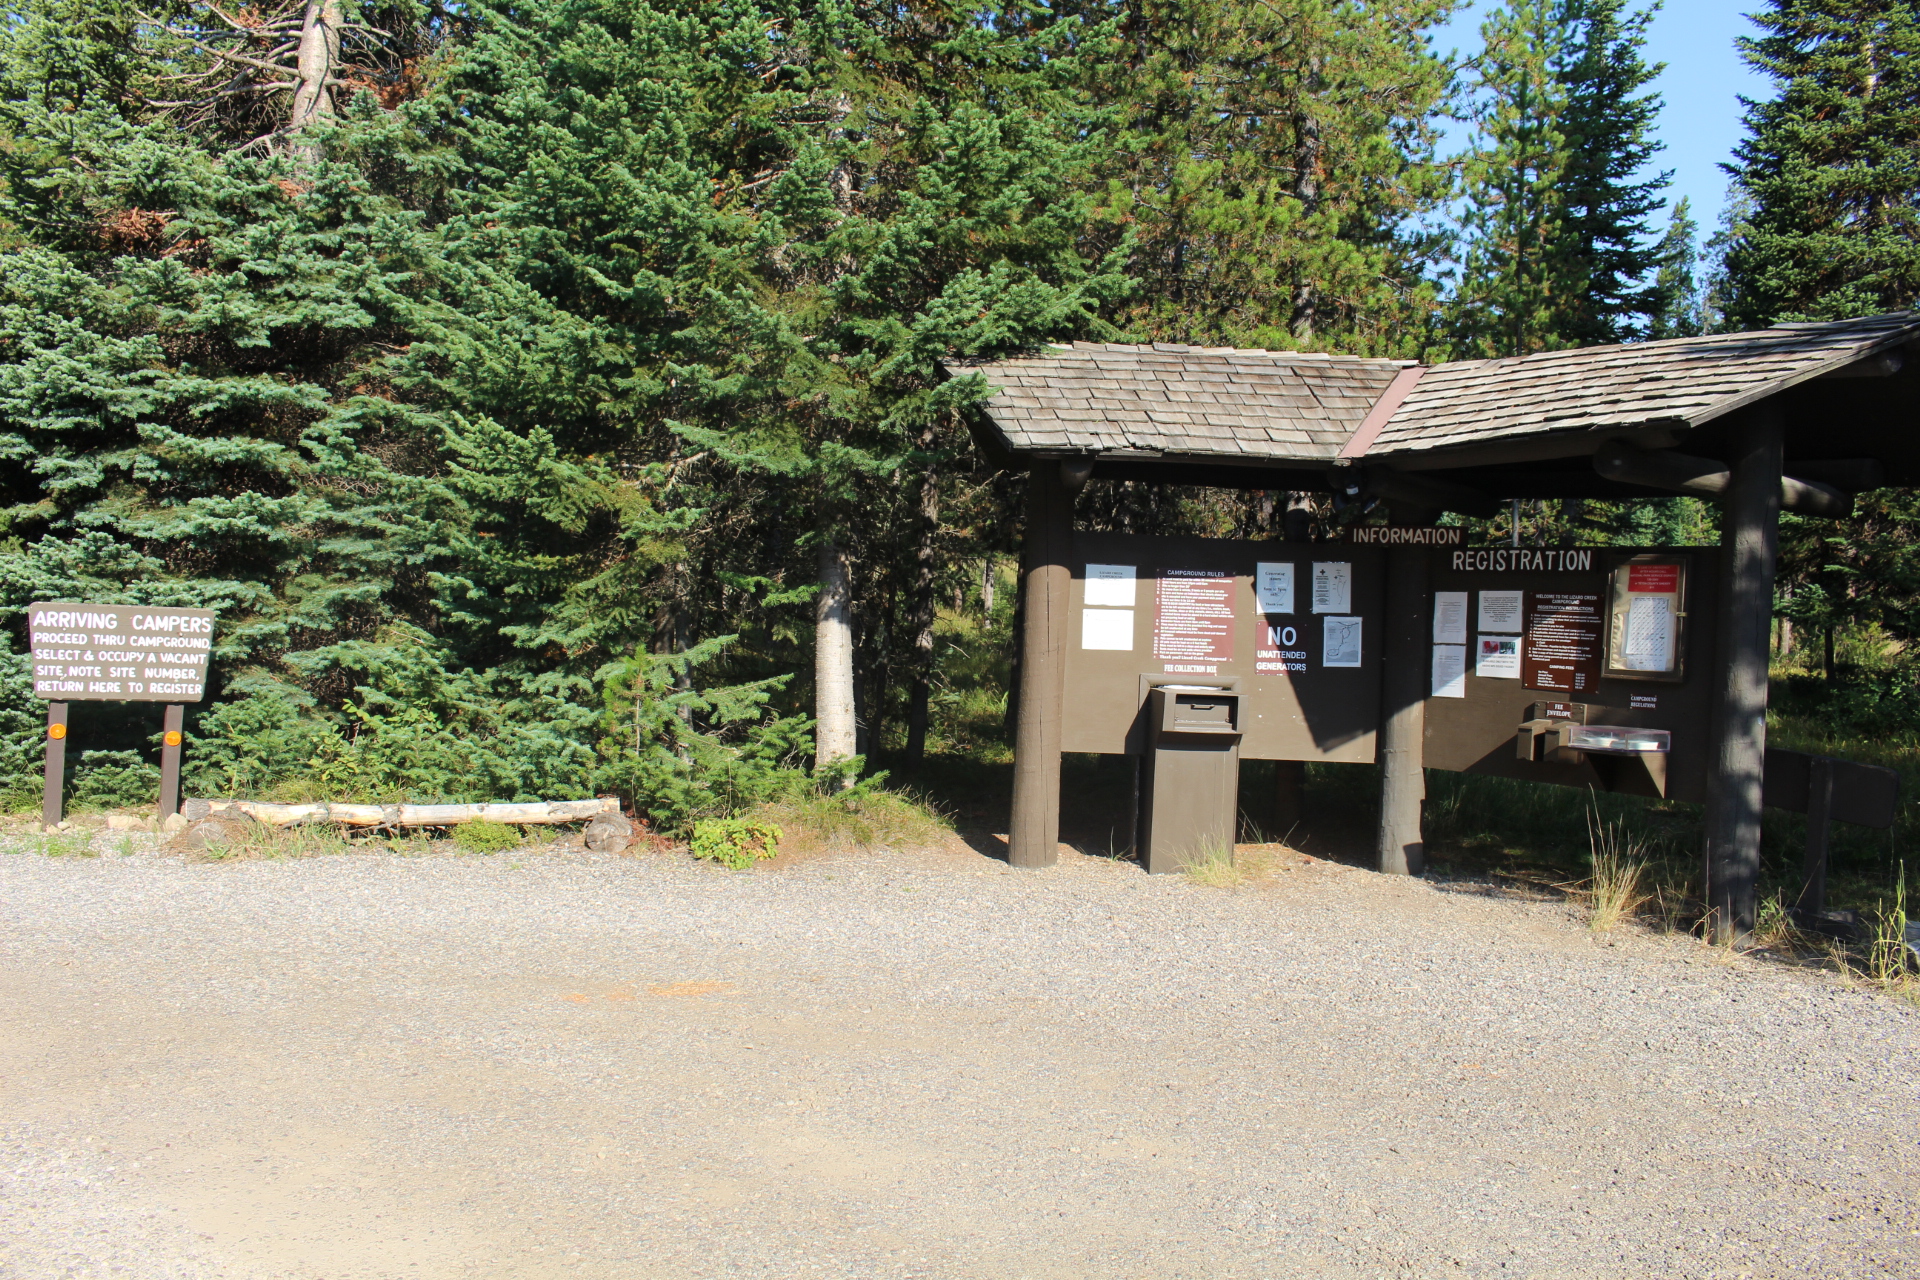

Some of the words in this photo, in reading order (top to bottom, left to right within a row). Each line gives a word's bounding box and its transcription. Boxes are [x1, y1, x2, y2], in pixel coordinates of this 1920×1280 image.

[1353, 527, 1460, 544] INFORMATION
[1453, 550, 1591, 571] REGISTRATION
[33, 611, 118, 629] ARRIVING
[132, 614, 211, 633] CAMPERS
[33, 632, 88, 645] PROCEED
[93, 634, 125, 646] THRU
[130, 635, 211, 650] CAMPGROUND,
[1267, 626, 1297, 646] NO
[35, 649, 81, 661] SELECT
[83, 650, 94, 661] &
[99, 651, 145, 662] OCCUPY
[147, 652, 156, 664] A
[160, 653, 206, 665] VACANT
[1257, 650, 1306, 659] UNATTENDED
[68, 666, 102, 678] NOTE
[109, 667, 136, 678] SITE
[144, 667, 200, 681] NUMBER,
[1164, 664, 1174, 672] FEE
[1174, 664, 1206, 673] COLLECTION
[1206, 665, 1217, 673] BOX
[1256, 662, 1306, 671] GENERATORS
[36, 680, 84, 692] RETURN
[89, 681, 121, 693] HERE
[128, 682, 143, 693] TO
[150, 683, 202, 694] REGISTER
[1547, 709, 1571, 718] ENVELOPE
